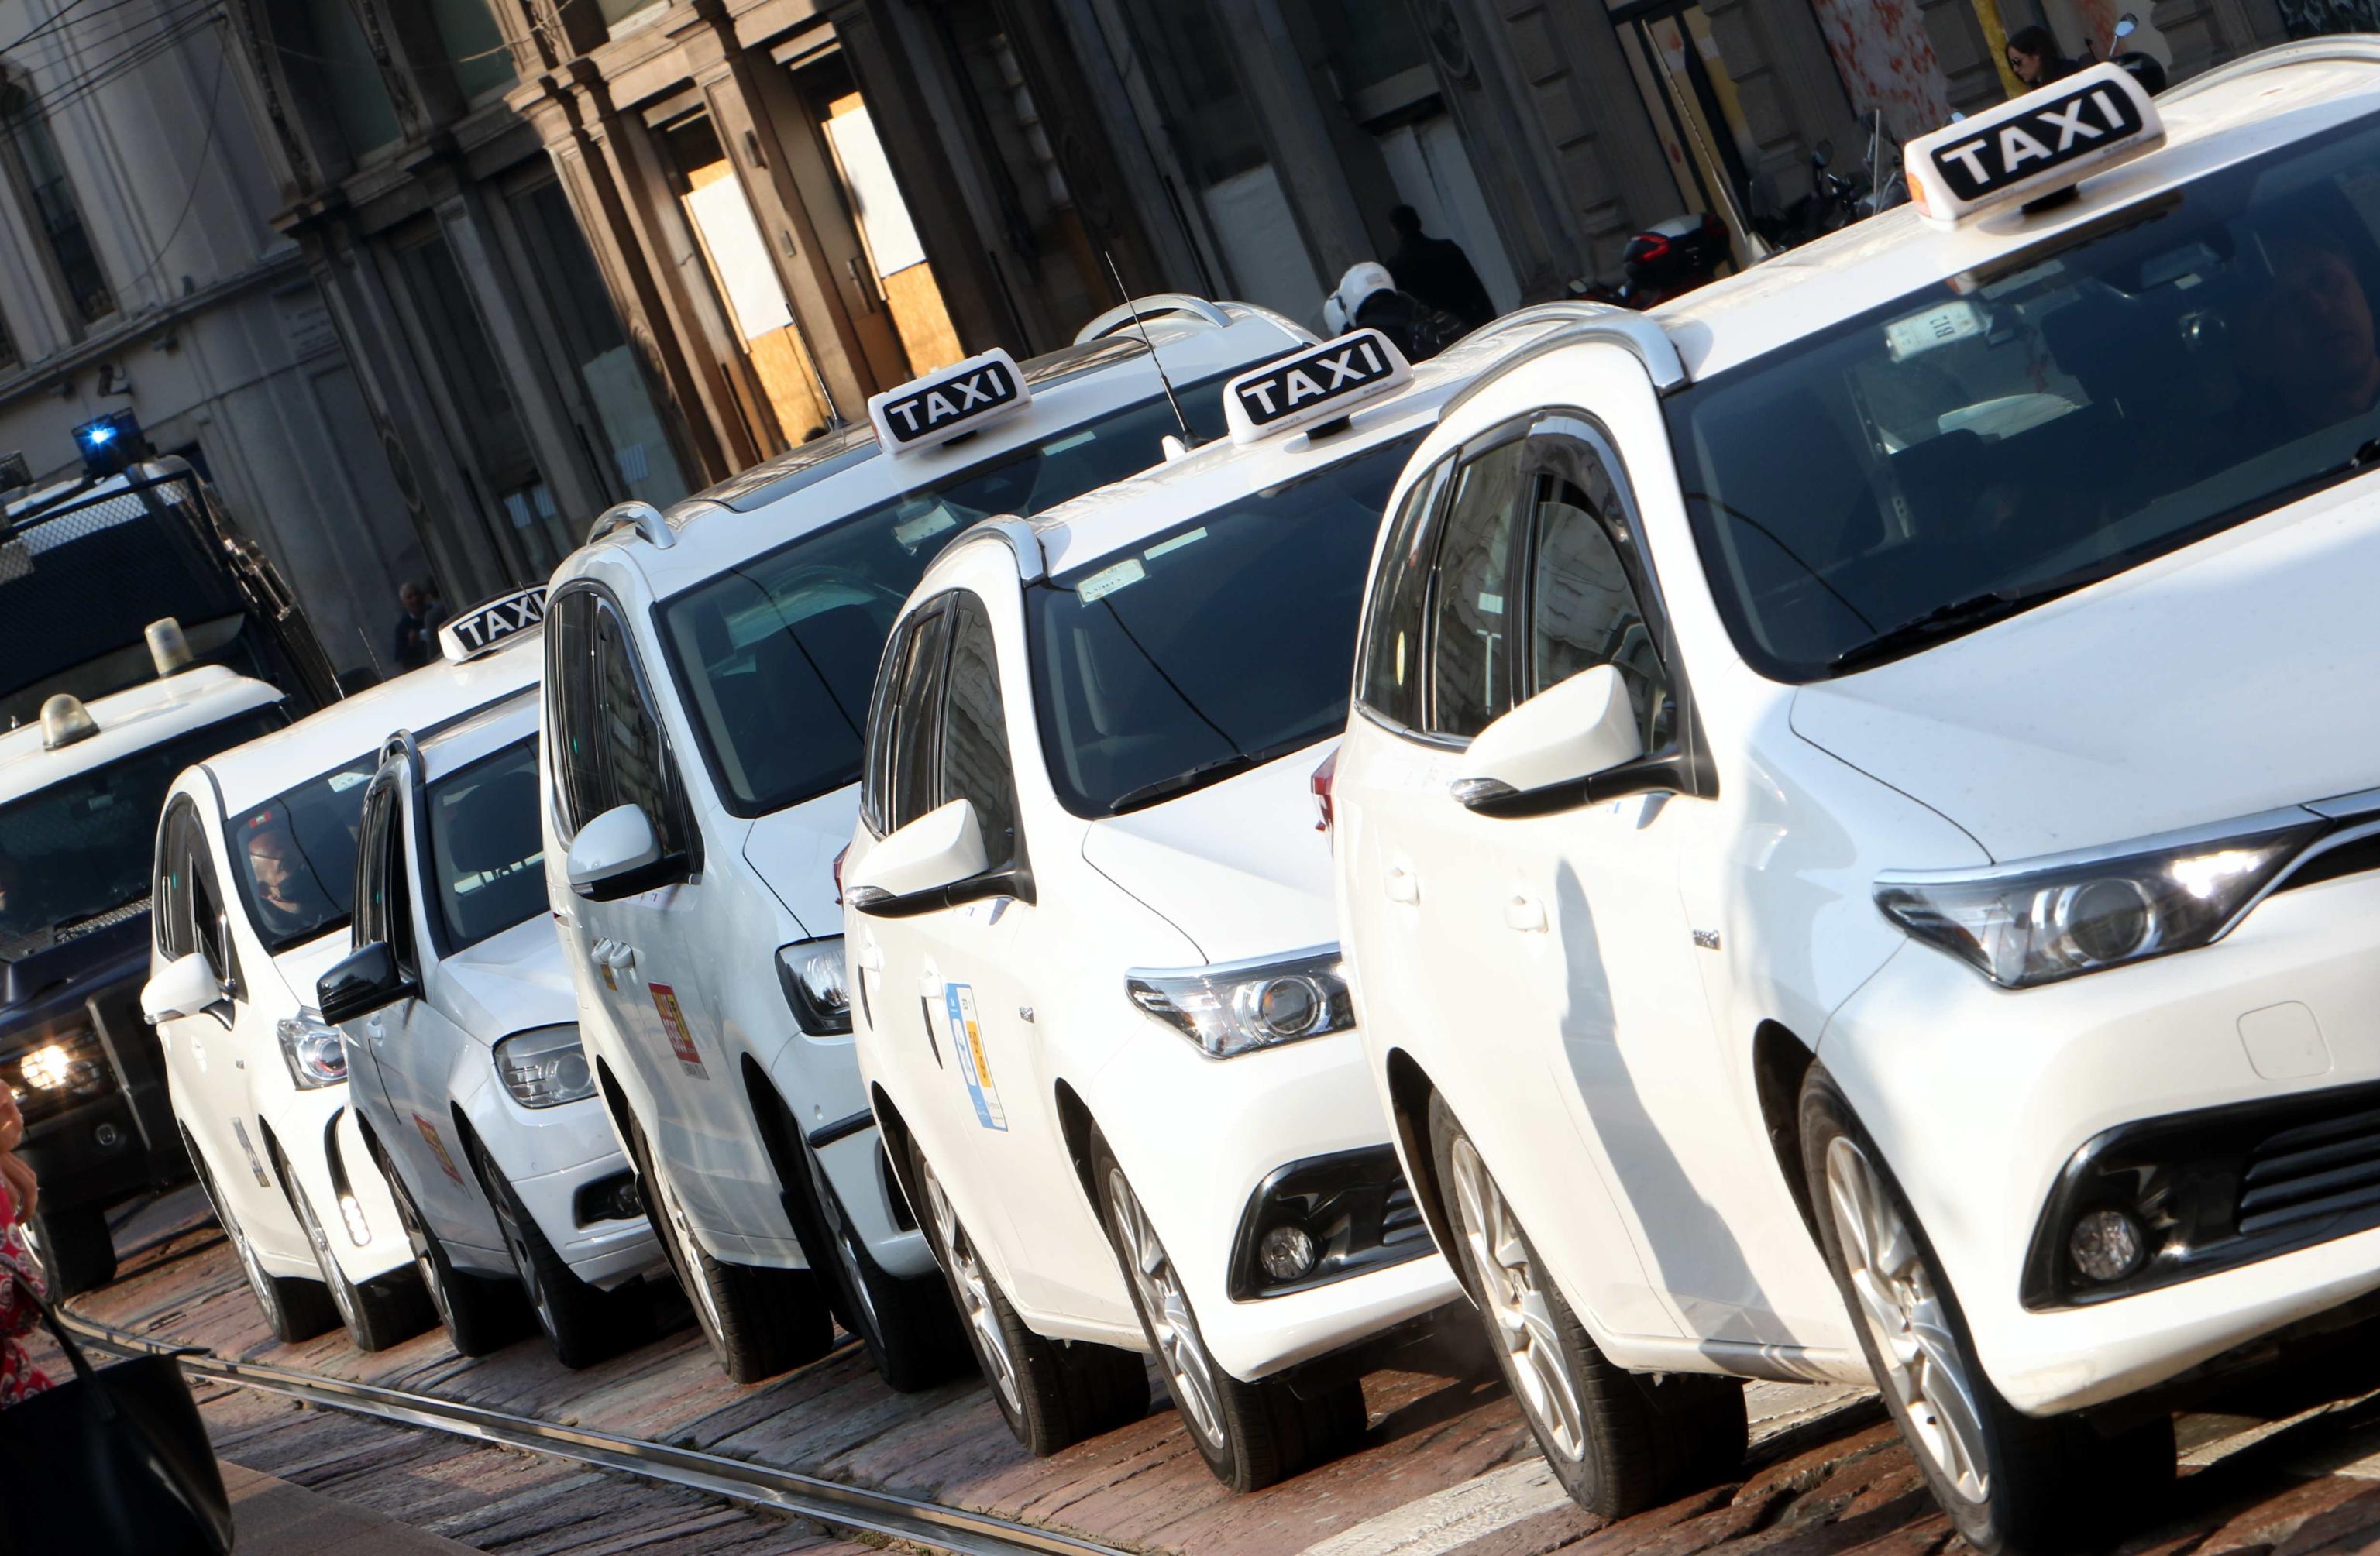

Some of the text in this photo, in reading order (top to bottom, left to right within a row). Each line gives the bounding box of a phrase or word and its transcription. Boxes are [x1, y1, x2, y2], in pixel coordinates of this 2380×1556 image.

[1941, 90, 2125, 184] TAXI
[889, 369, 1006, 431] TAXI
[1241, 342, 1383, 414] TAXI
